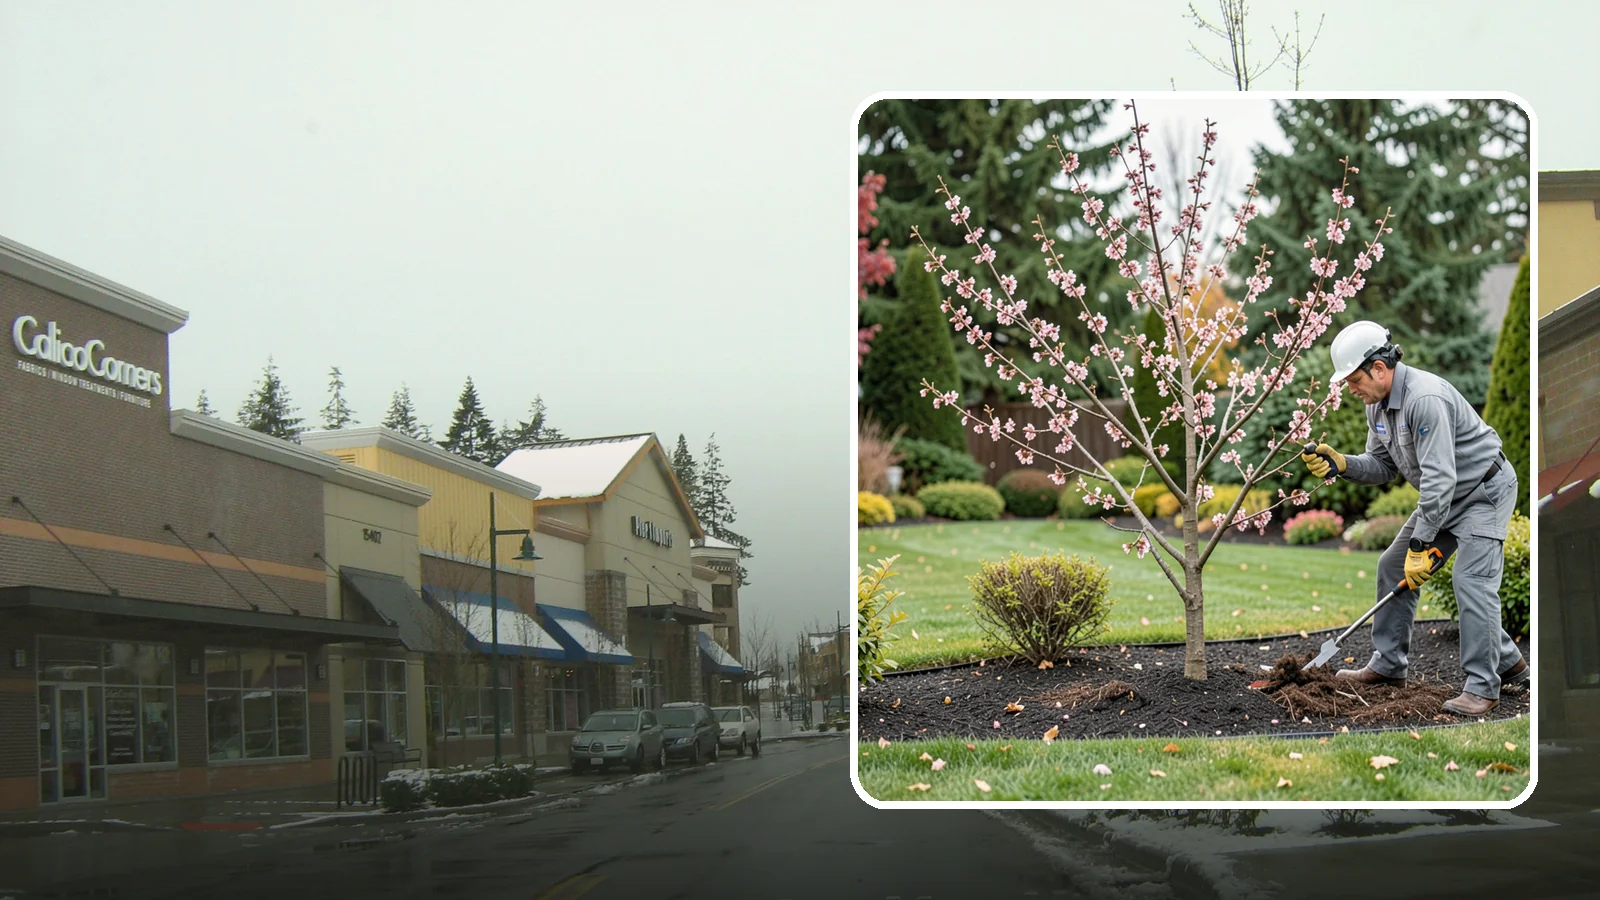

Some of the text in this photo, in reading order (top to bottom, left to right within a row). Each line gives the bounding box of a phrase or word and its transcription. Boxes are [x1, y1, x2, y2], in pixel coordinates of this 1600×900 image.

[17, 359, 47, 378] FABRICS
[51, 370, 78, 387] WINDOW
[78, 378, 116, 399] TREATMENTS
